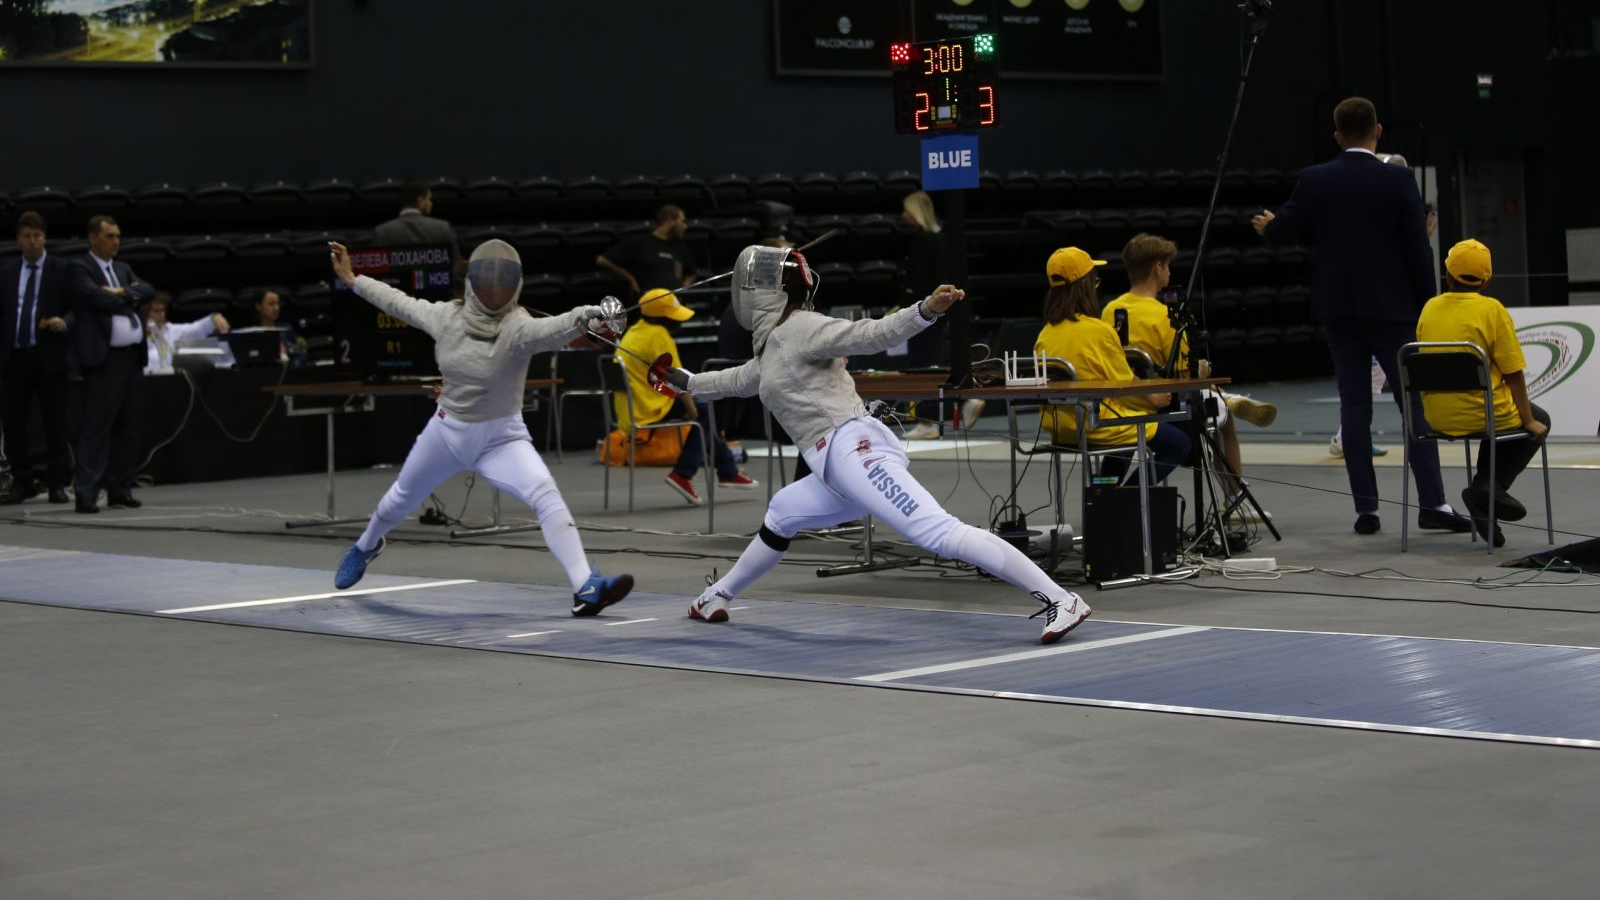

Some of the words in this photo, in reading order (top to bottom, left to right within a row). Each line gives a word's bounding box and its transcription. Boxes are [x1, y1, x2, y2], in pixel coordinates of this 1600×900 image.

[923, 44, 963, 75] 3:00
[915, 92, 930, 131] 2
[979, 86, 994, 125] 3
[928, 149, 972, 170] BLUE
[340, 339, 351, 363] 2
